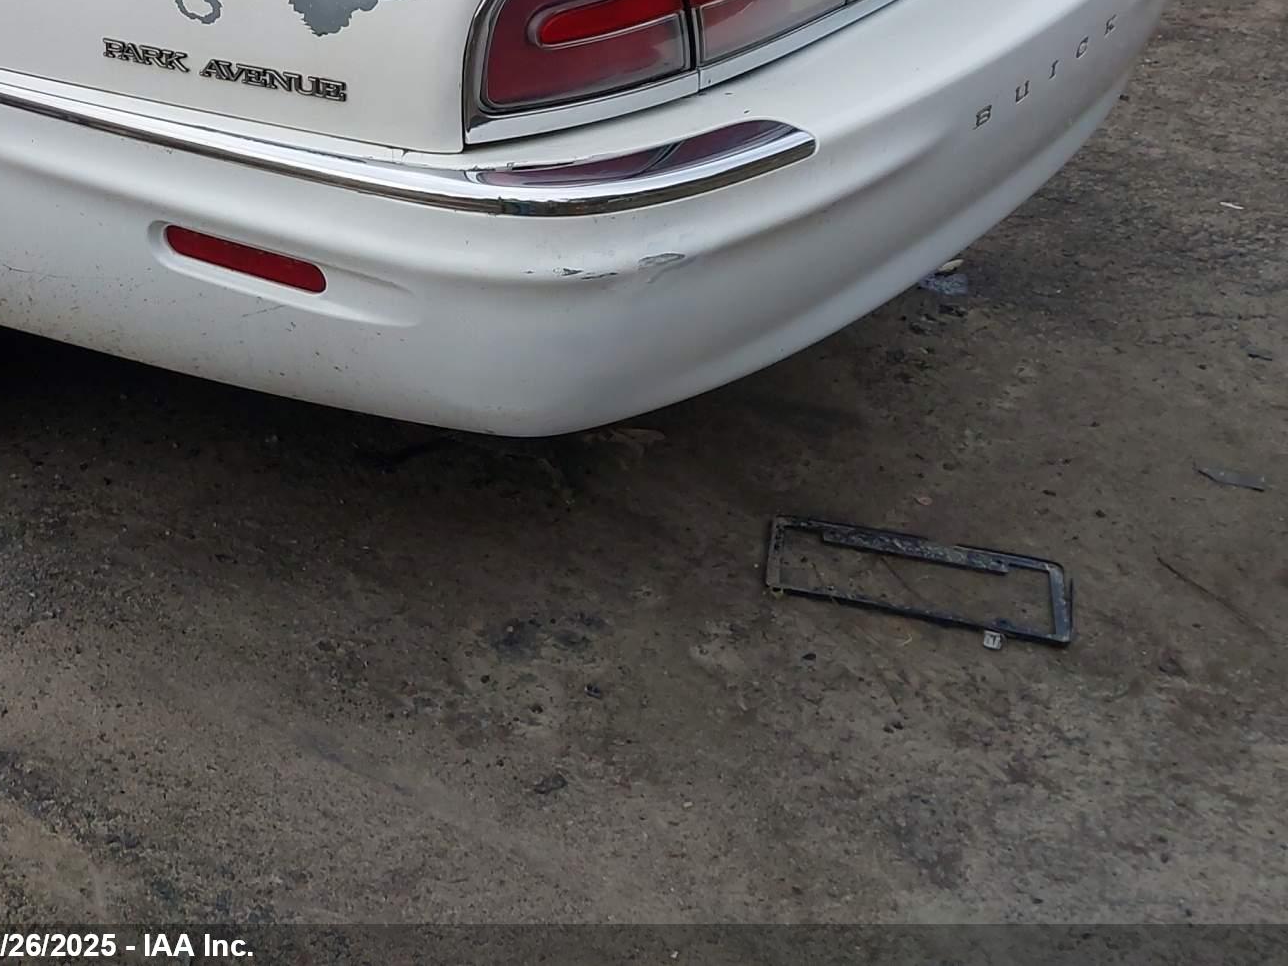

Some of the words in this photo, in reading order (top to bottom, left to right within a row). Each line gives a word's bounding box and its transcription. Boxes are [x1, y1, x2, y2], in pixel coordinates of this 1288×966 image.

[102, 38, 190, 73] PARK
[199, 59, 347, 102] AVENUE
[973, 13, 1117, 131] BUICK
